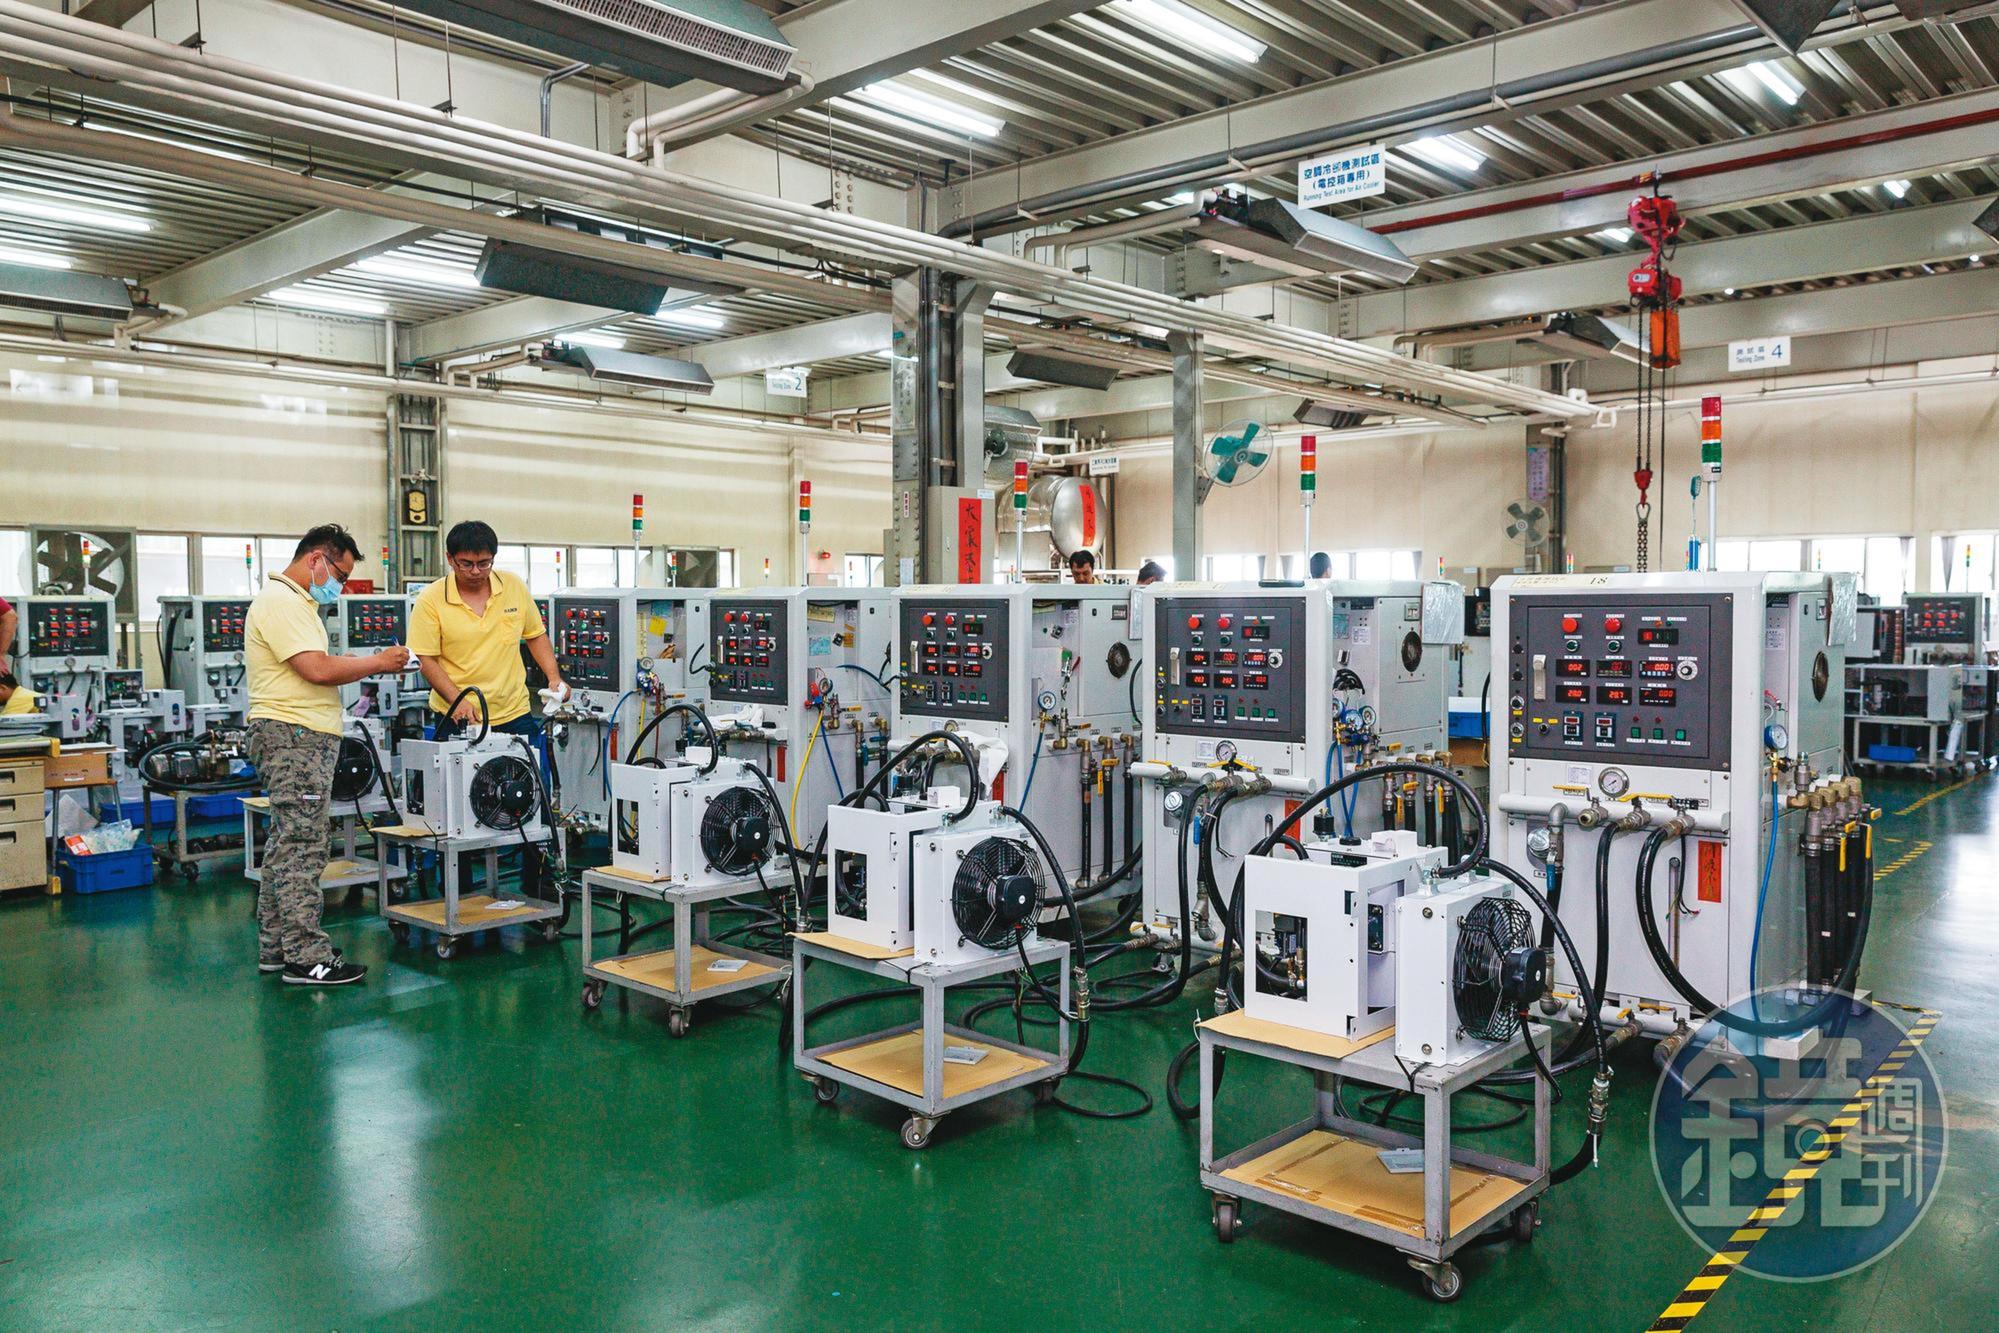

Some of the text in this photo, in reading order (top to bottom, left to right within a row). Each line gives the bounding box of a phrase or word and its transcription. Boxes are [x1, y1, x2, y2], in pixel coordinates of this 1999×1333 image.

[1771, 344, 1783, 359] 4
[795, 377, 802, 391] 2
[309, 963, 332, 980] N
